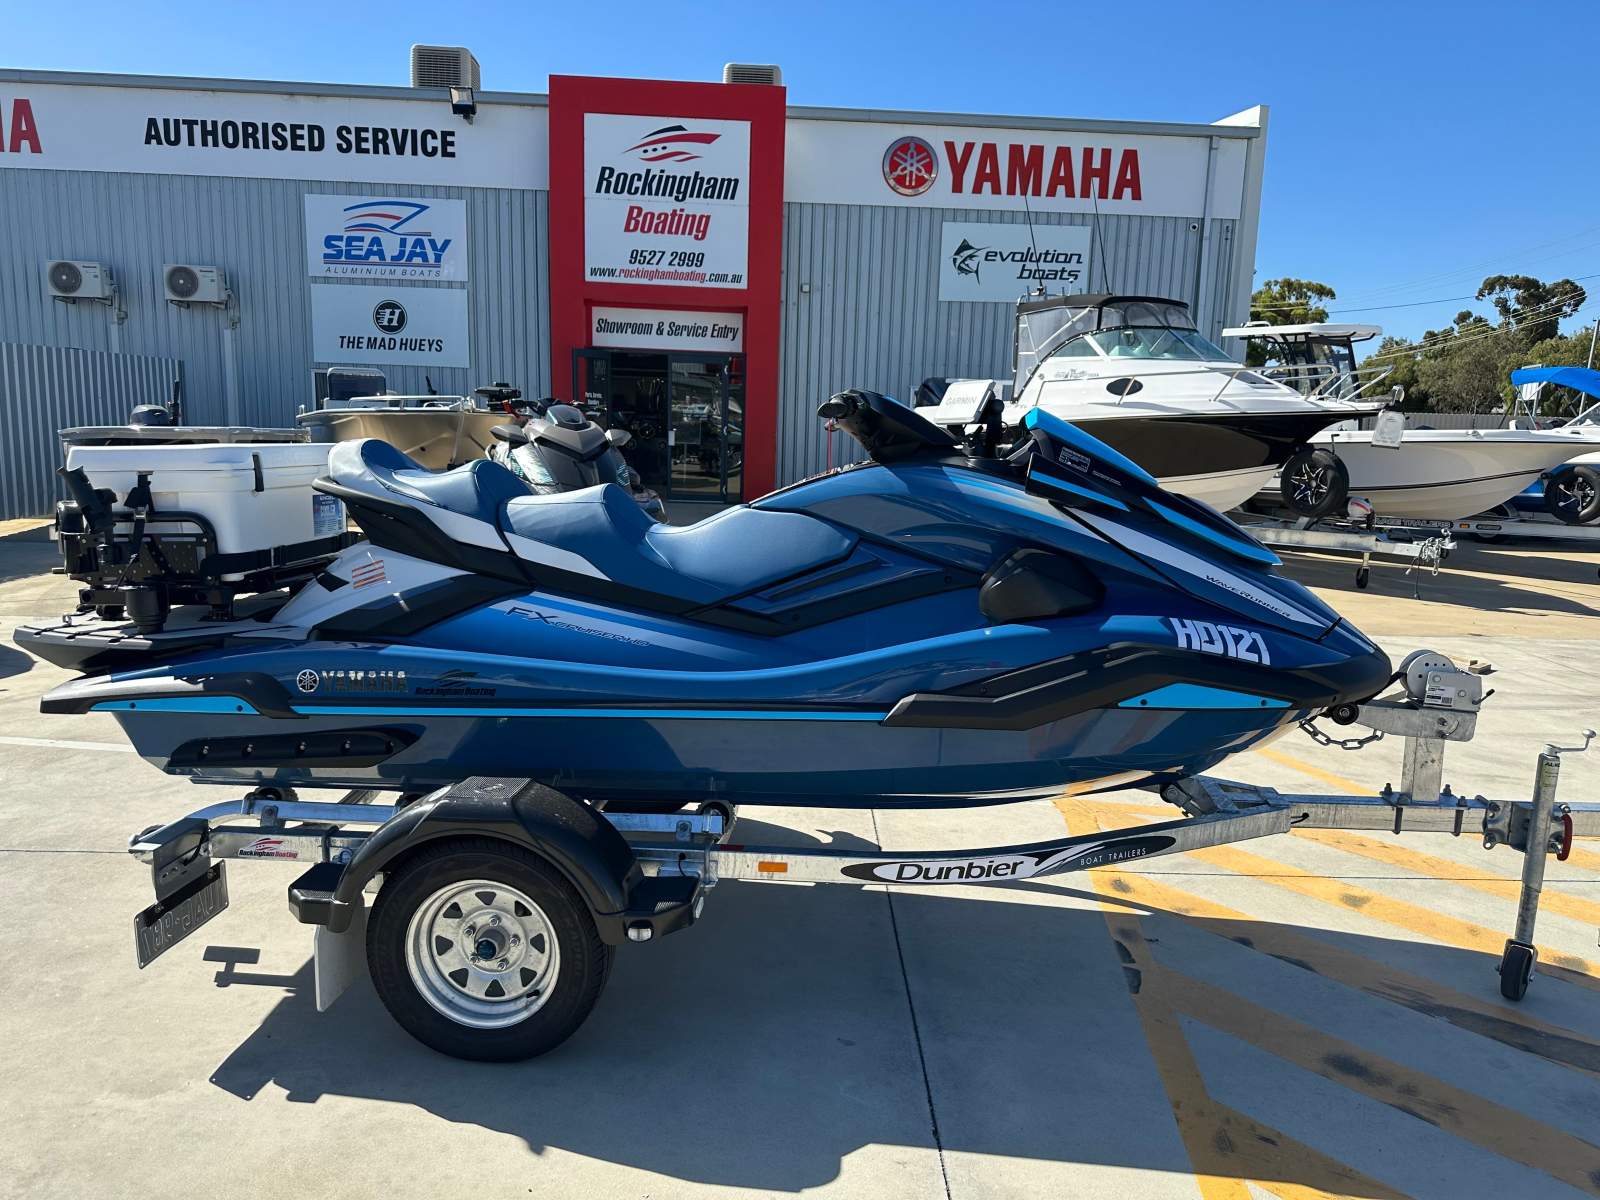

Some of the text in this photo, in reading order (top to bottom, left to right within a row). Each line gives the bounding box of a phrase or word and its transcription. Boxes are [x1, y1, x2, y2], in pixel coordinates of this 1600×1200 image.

[144, 117, 456, 158] AUTHORISED SERVICE
[943, 140, 1142, 200] YAMAHA
[595, 166, 739, 202] Rockingham
[623, 205, 711, 241] Boating
[322, 234, 452, 263] SEA JAY
[628, 249, 705, 267] 9527 2999
[984, 246, 1083, 264] evolution
[325, 266, 441, 277] ALUMINIUM BOATS
[590, 266, 743, 284] www.rockinghamboating.com.au
[1016, 263, 1081, 281] boats
[595, 318, 739, 341] Showroom & Service Entry
[339, 335, 444, 352] THE MAD HUEYS
[504, 606, 559, 625] FX
[1169, 617, 1271, 666] HD121
[239, 849, 298, 859] Rockingham Boating
[895, 847, 1147, 881] Dunbier BOAT TRAILERS
